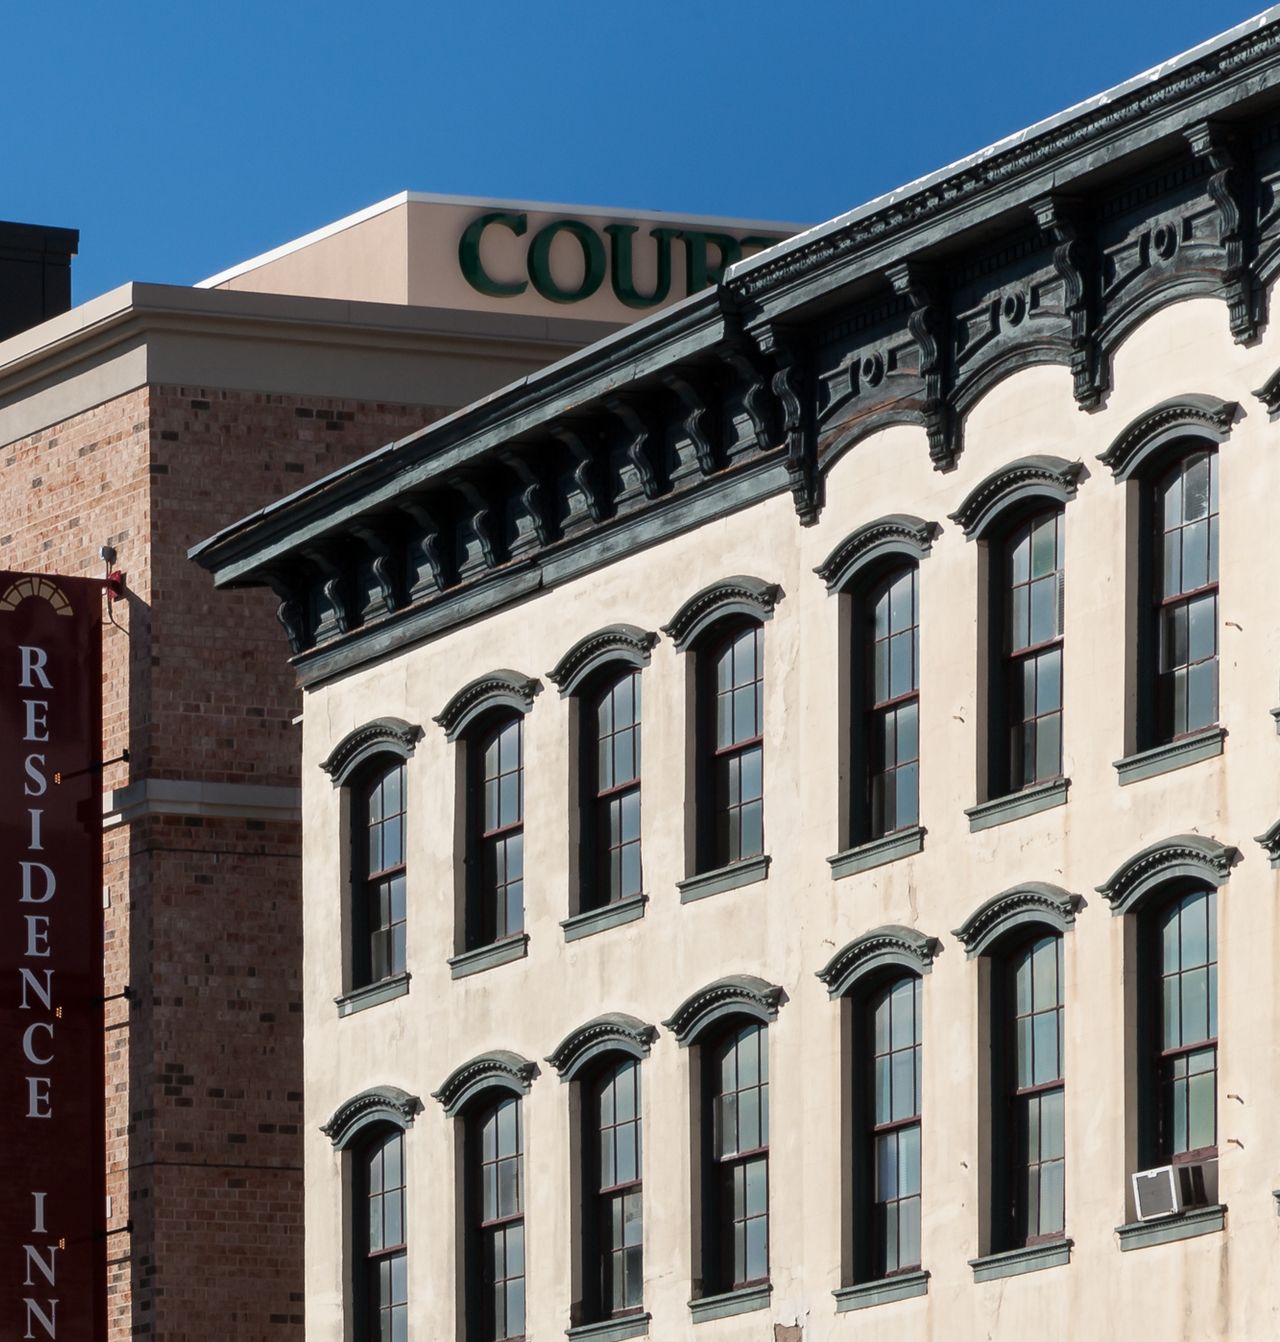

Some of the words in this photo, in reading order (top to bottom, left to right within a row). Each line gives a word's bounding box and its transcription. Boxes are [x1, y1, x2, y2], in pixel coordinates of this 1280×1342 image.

[458, 212, 781, 309] COUR
[17, 645, 57, 1119] RESIDENCE
[22, 1191, 59, 1341] INN
